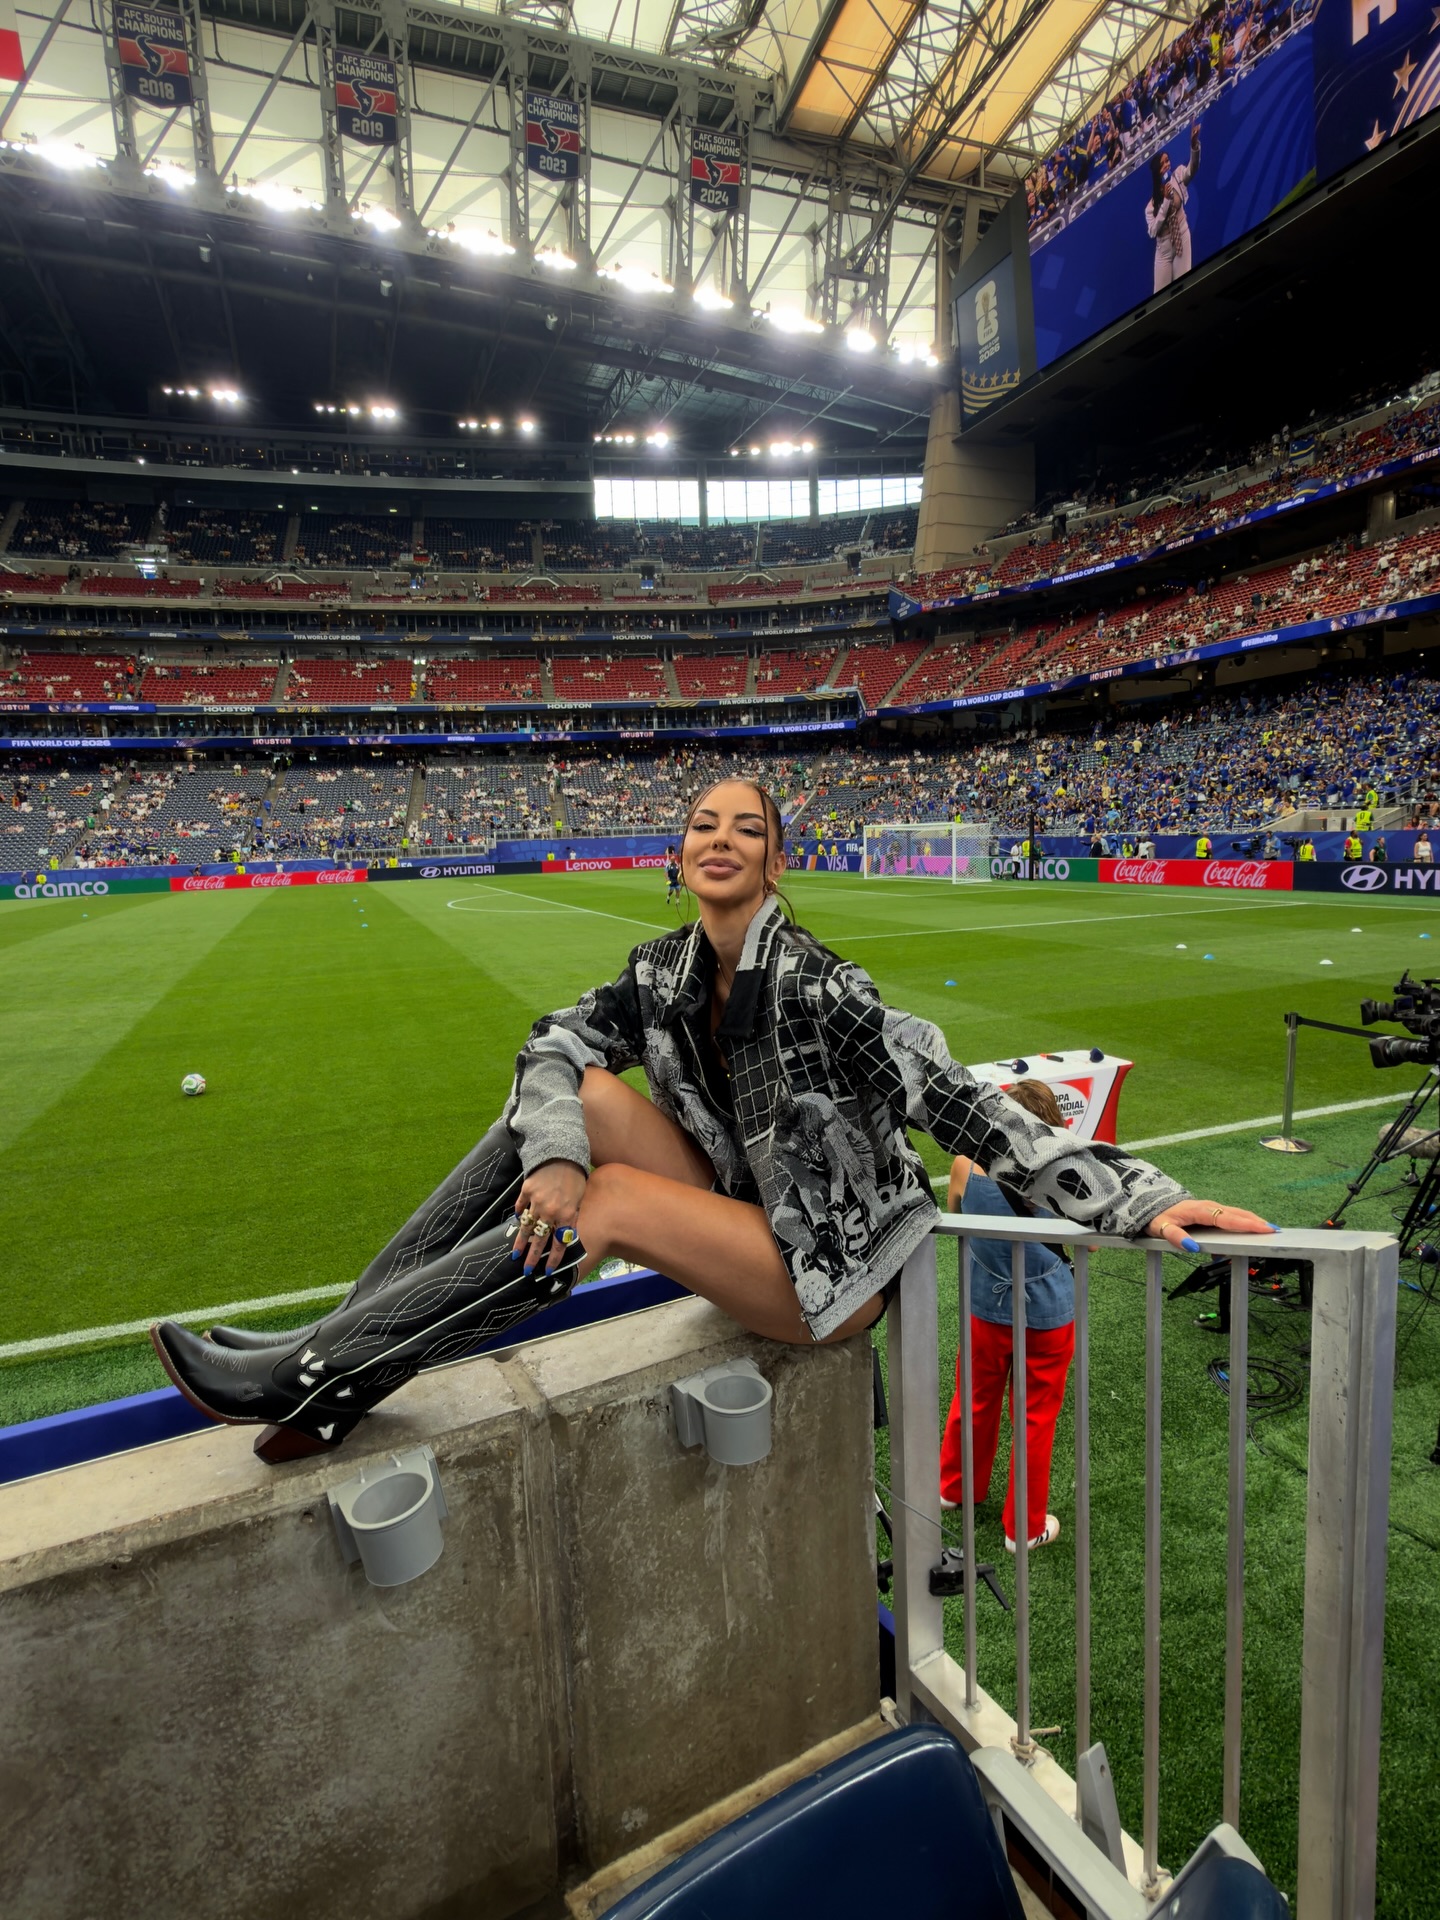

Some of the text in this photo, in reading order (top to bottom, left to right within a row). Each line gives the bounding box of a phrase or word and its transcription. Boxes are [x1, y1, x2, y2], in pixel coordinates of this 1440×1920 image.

[123, 8, 175, 28] AFC SOUTH
[116, 16, 184, 41] CHAMPIONS
[342, 54, 387, 72] AFC SOUTH
[336, 62, 394, 85] CHAMPIONS
[138, 77, 175, 100] 2018
[527, 103, 578, 124] CHAMPIONS
[533, 96, 573, 113] AFC SOUTH
[351, 117, 384, 138] 2019
[693, 139, 740, 158] CHAMPIONS
[699, 132, 736, 147] AFC SOUTH
[539, 154, 567, 174] 2023
[700, 187, 729, 206] 2024
[979, 342, 1001, 364] 2026
[1165, 535, 1195, 551] HOUSTON
[1051, 561, 1116, 585] FIFA WORLD CUP 2026
[1089, 667, 1124, 682] HOUSTON
[952, 689, 1026, 708] FIFA WORLD CUP 2026
[620, 731, 654, 739] HOUSTON
[784, 725, 807, 733] WORLD
[821, 722, 845, 730] 2026
[31, 740, 63, 748] WORLD
[63, 740, 82, 748] CUP
[81, 739, 112, 747] 2026
[845, 843, 859, 853] FIFA
[443, 864, 496, 876] HYUNDAI
[565, 860, 612, 872] Lenovo
[632, 856, 668, 868] Lenov
[826, 855, 849, 872] VISA
[14, 880, 109, 899] aramco
[1054, 1093, 1070, 1102] OPA
